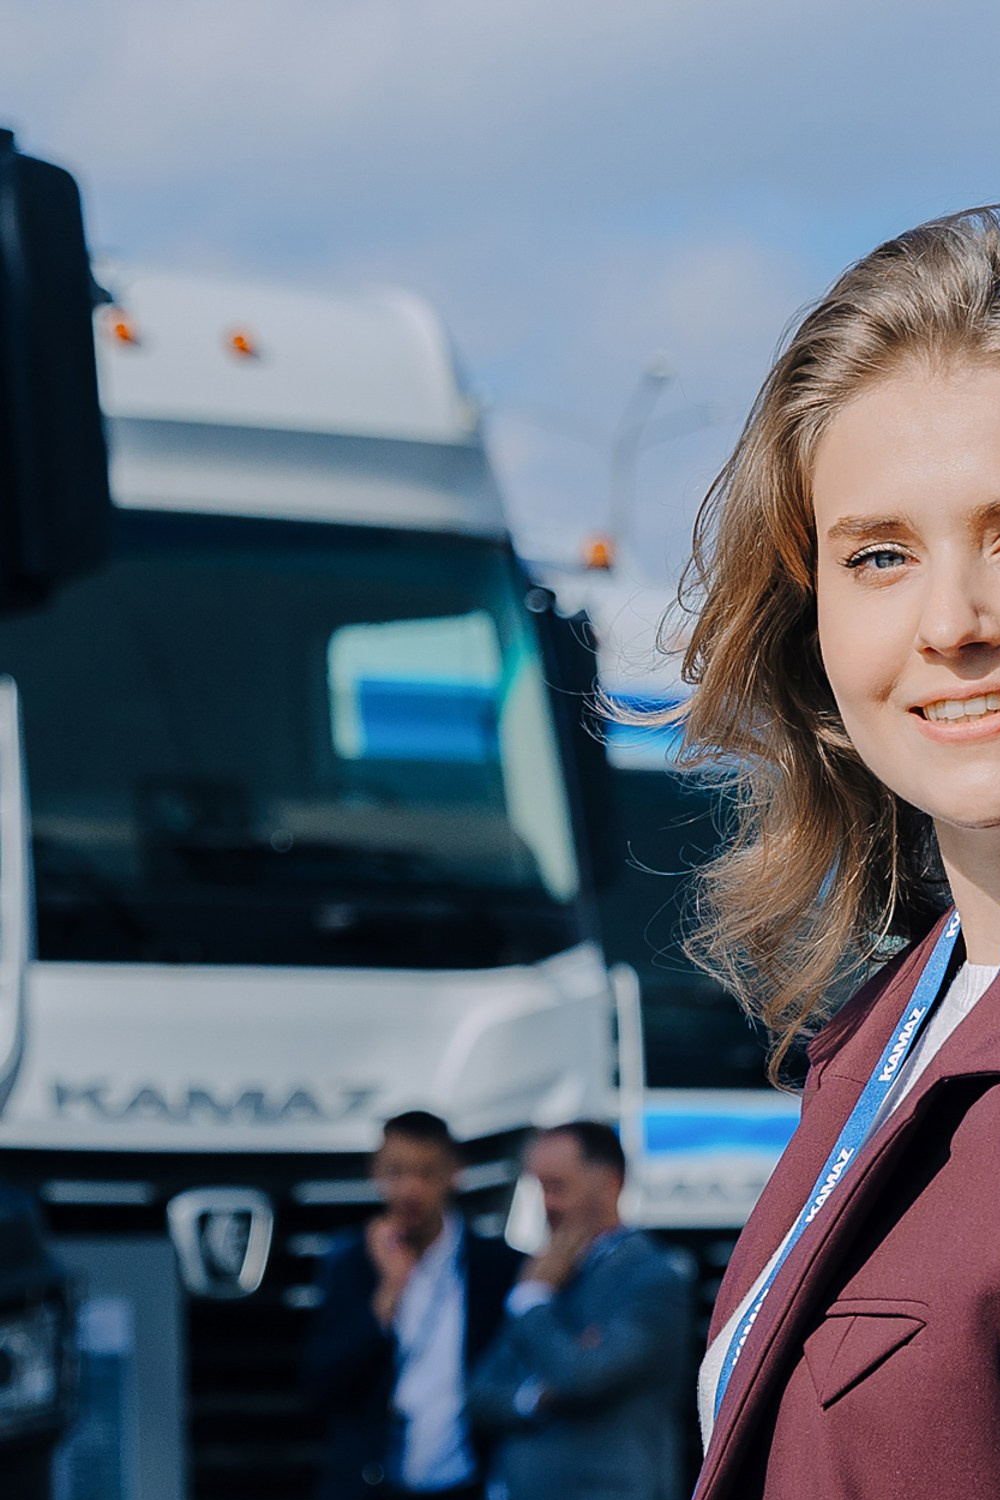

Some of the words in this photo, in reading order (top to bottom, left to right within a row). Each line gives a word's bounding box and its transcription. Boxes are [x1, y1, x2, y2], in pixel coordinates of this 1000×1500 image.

[878, 1006, 926, 1082] KAMAZ
[52, 1080, 386, 1123] KAMAZ
[805, 1148, 854, 1223] KAMAZ
